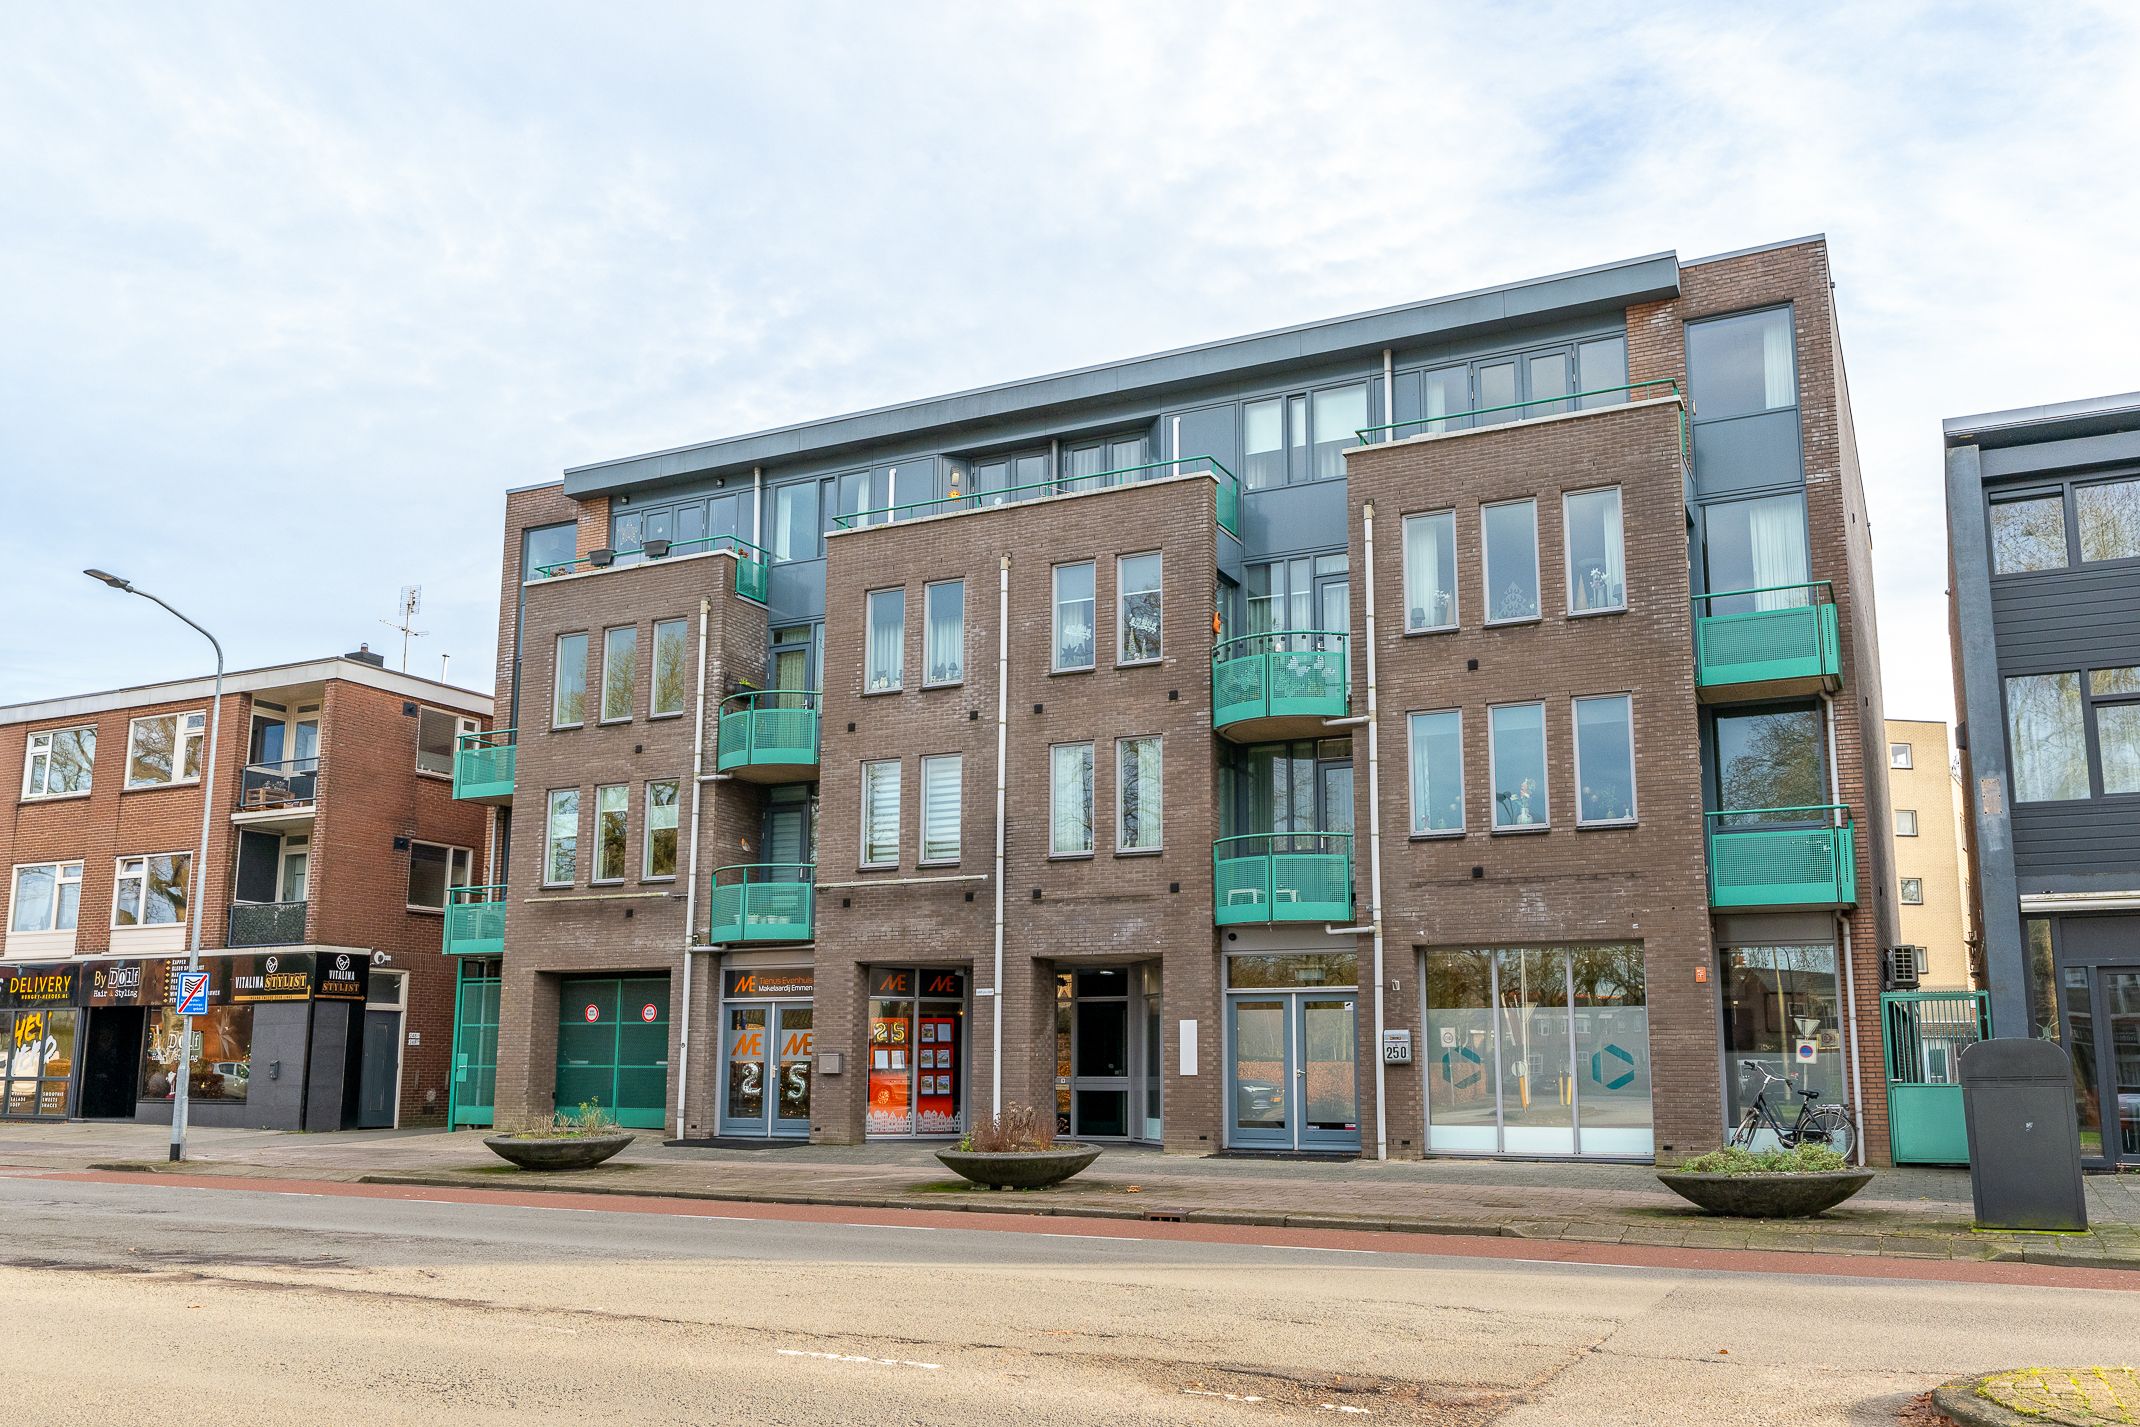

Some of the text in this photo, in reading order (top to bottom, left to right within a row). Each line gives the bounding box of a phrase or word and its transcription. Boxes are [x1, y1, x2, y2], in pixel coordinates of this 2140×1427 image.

[95, 968, 140, 988] By Dolf
[329, 970, 355, 980] VITALINA
[782, 975, 814, 984] Evenhuis
[9, 975, 72, 993] DELIVERY
[235, 973, 307, 990] VITALINA STYLIST
[322, 981, 360, 993] STYLIST
[115, 989, 138, 998] Styling
[758, 985, 791, 993] Makelaardij
[1386, 1046, 1407, 1059] 250
